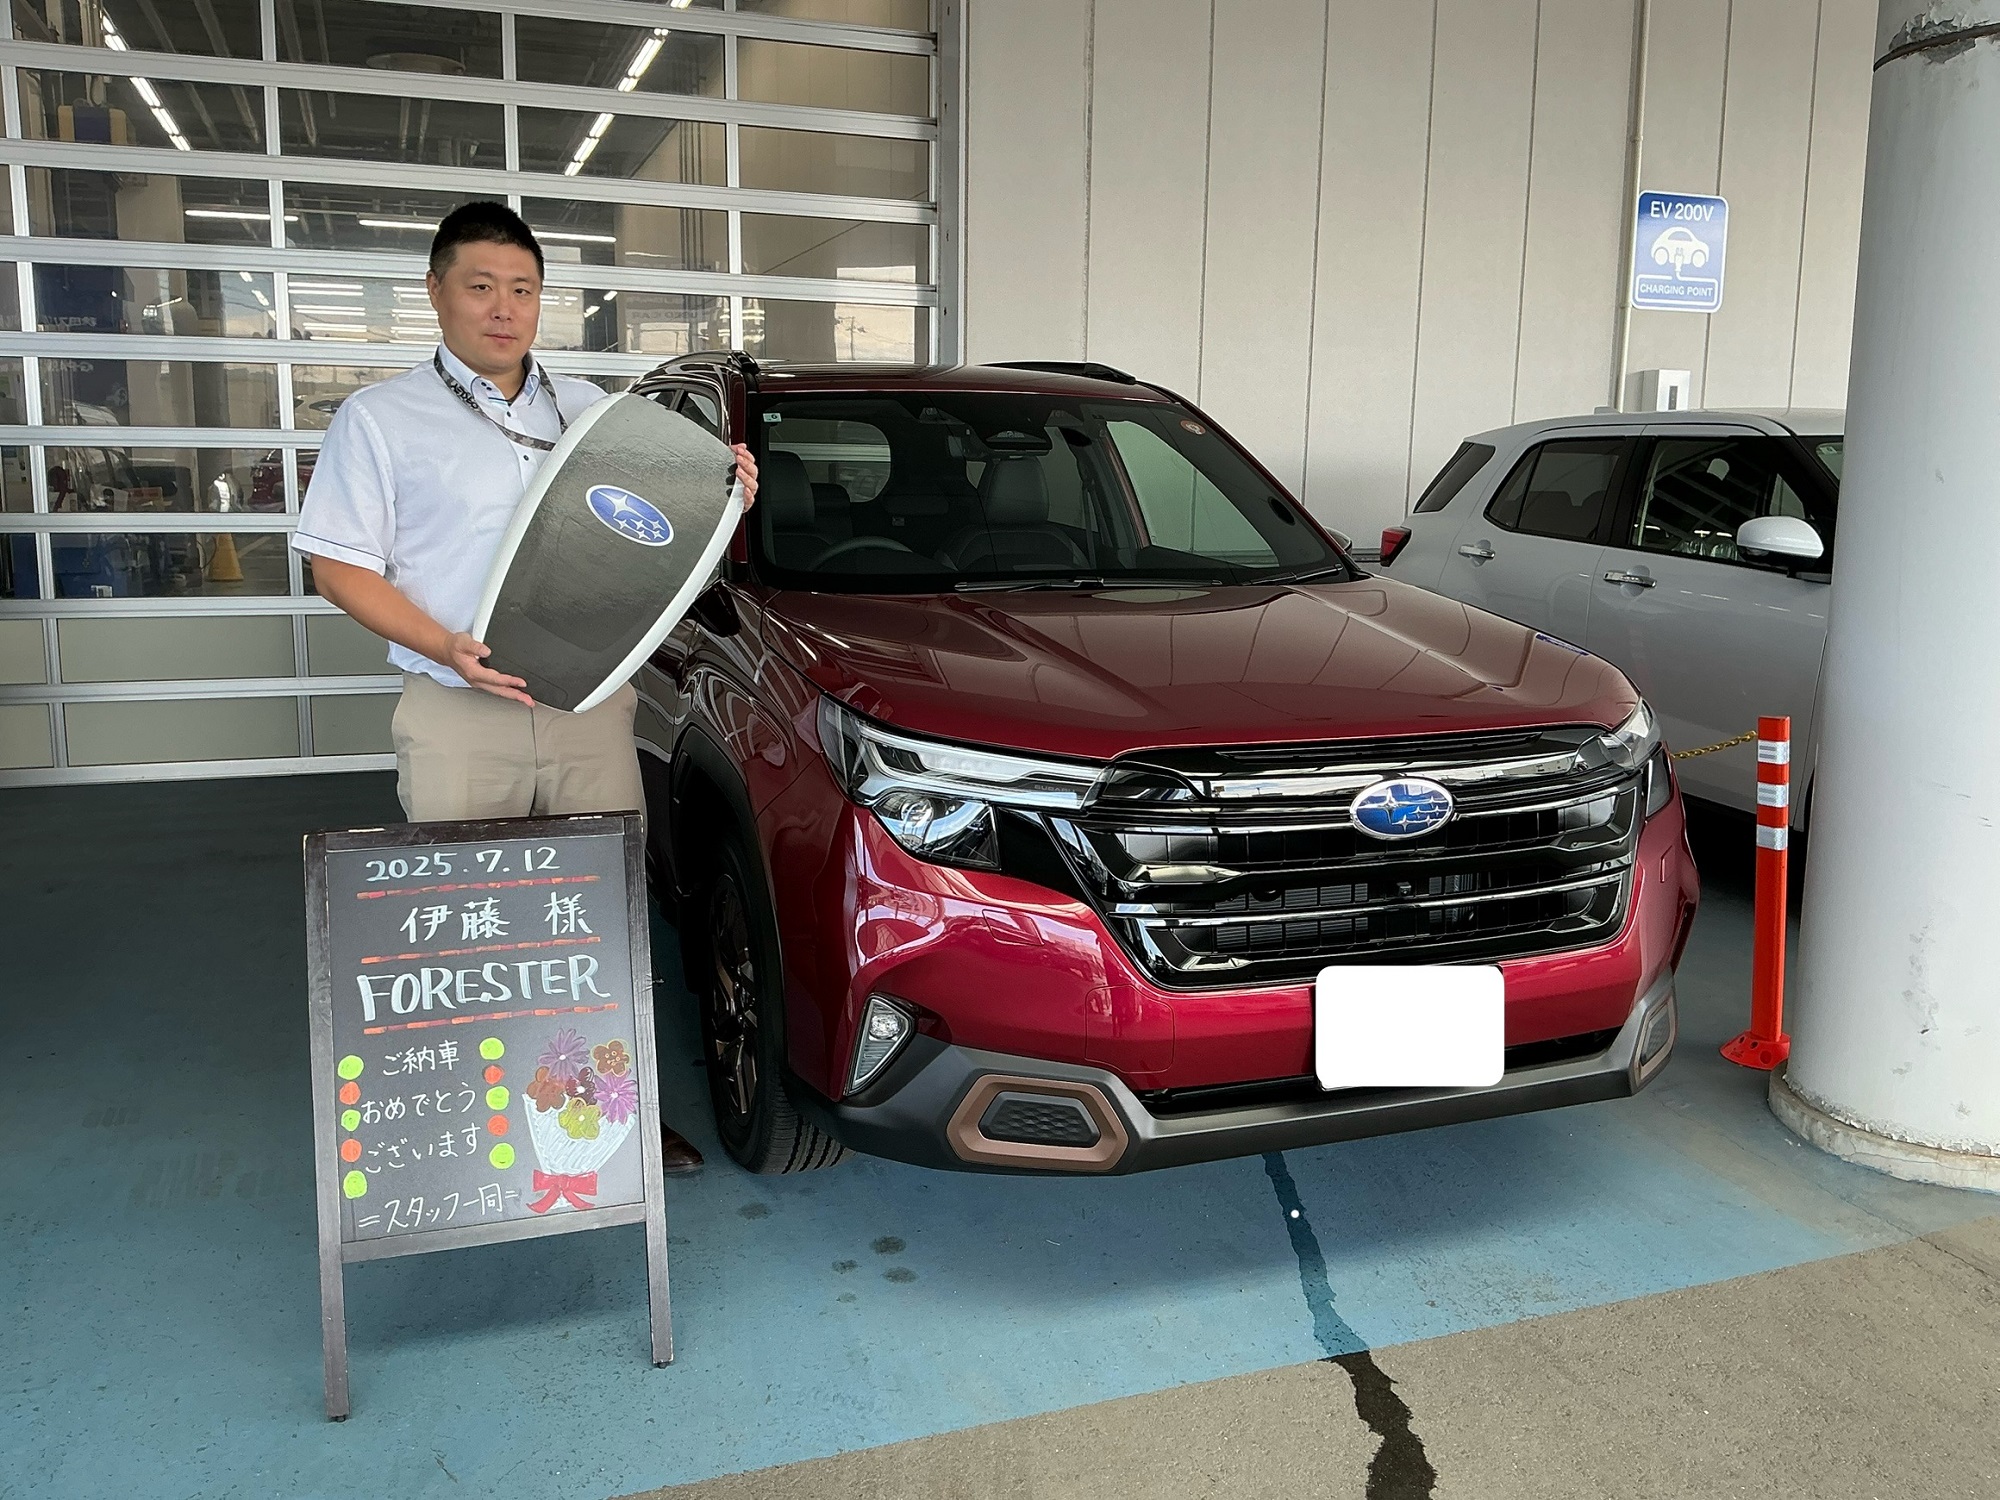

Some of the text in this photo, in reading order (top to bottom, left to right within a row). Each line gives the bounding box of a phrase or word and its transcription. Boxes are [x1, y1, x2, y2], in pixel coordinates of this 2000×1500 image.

[1650, 201, 1714, 221] EV 200V
[1640, 283, 1713, 297] CHARGING POINT
[451, 381, 479, 410] OAKLEY
[399, 896, 511, 943] 伊藤
[356, 954, 611, 1022] FORESTER
[382, 1040, 460, 1077] ご納車
[361, 1082, 477, 1125] おめでとう
[365, 1122, 482, 1174] ございます
